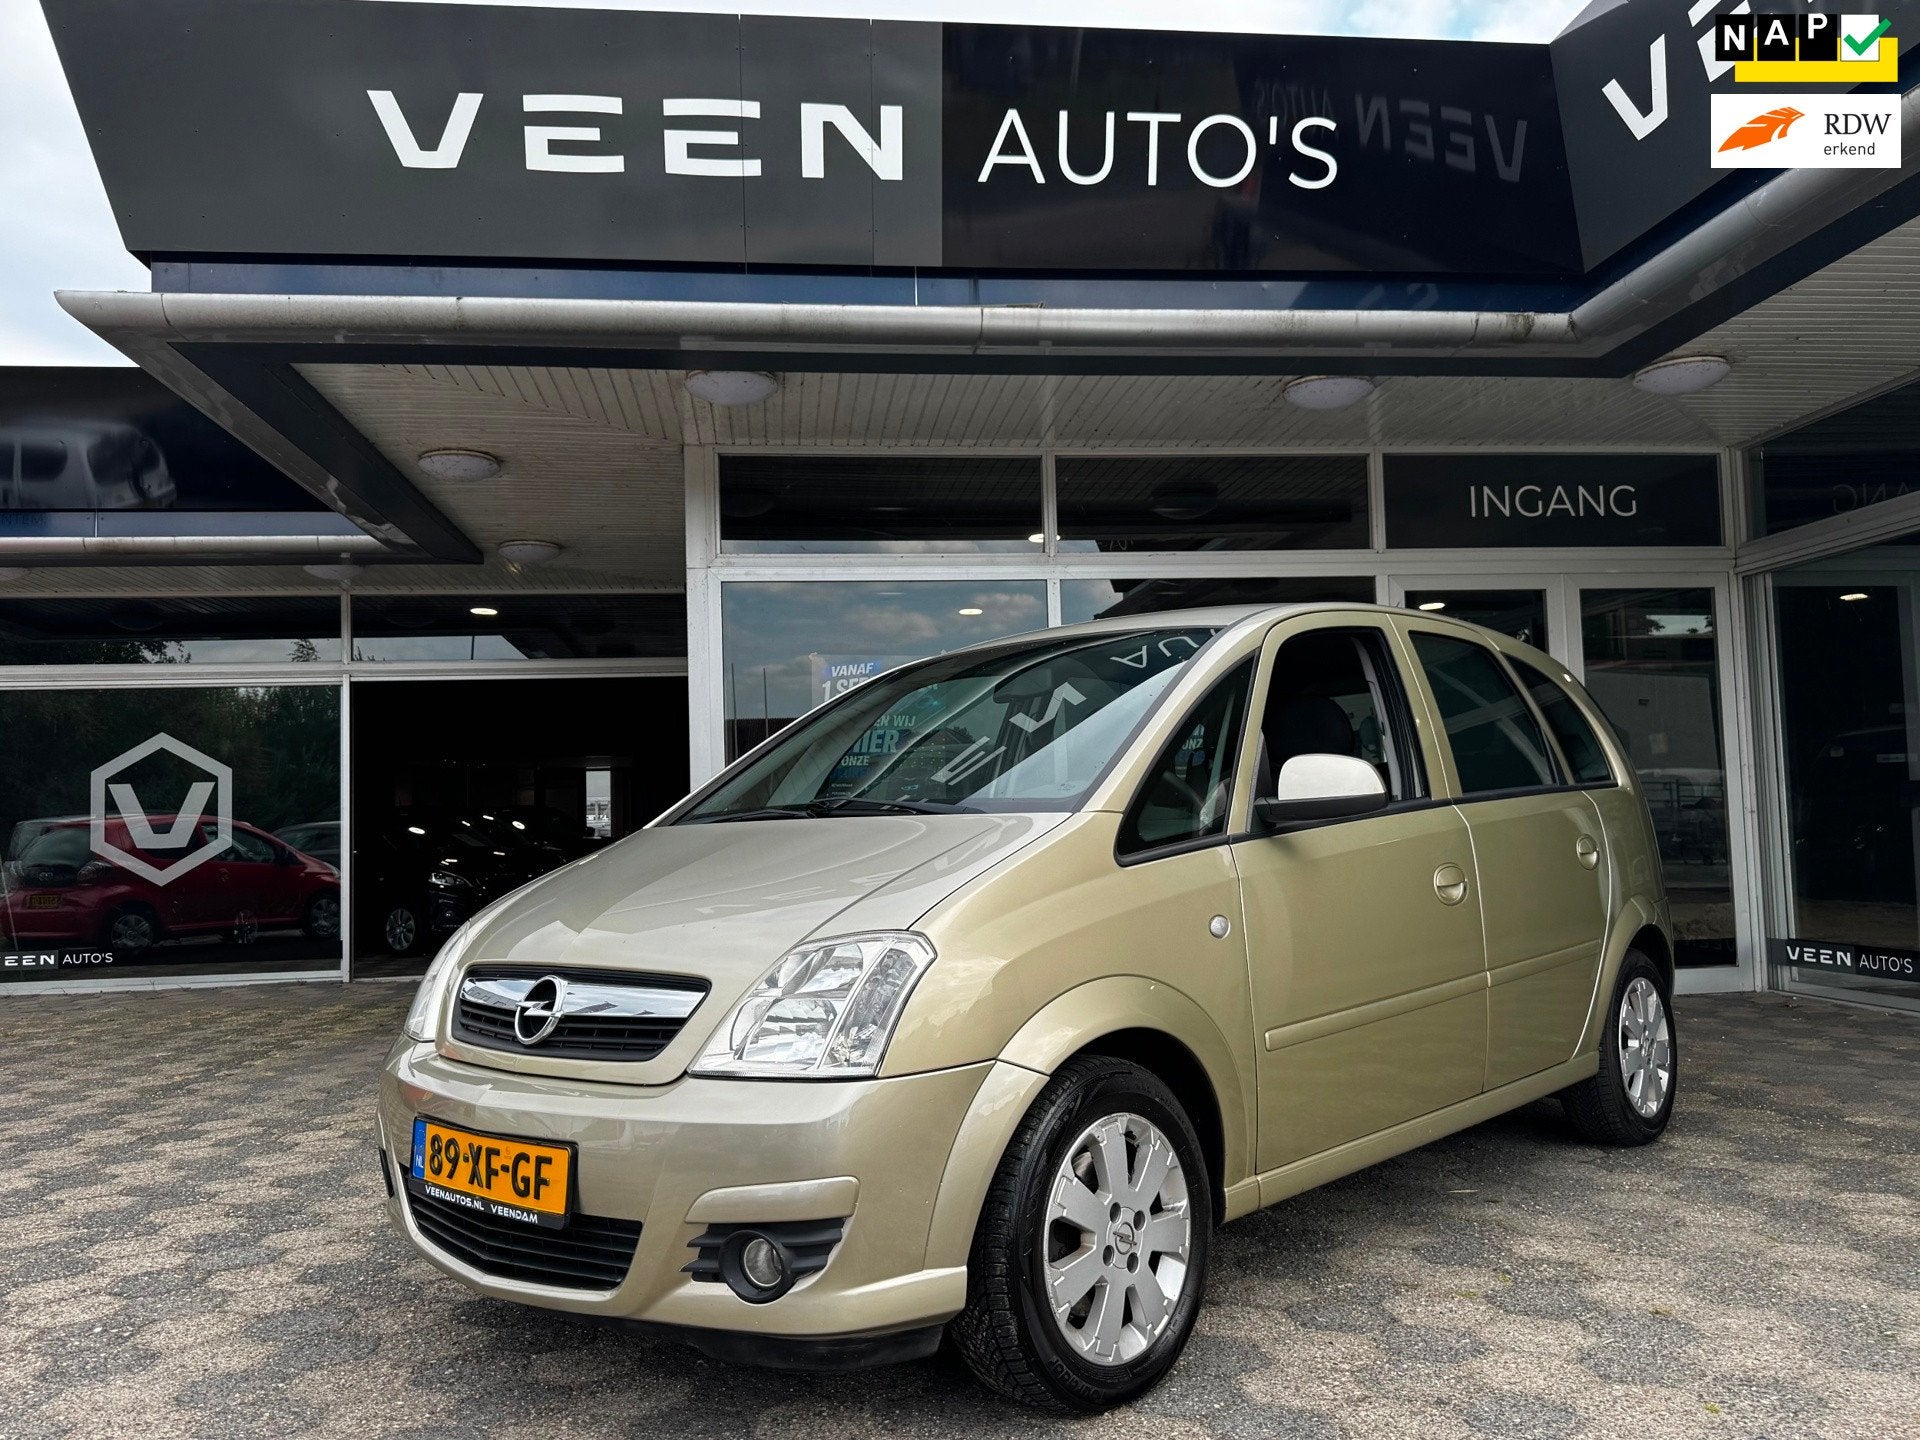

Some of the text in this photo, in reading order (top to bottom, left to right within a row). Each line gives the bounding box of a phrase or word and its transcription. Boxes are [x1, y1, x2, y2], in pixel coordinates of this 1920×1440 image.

[366, 90, 1338, 190] VEEN AUTO'S
[1470, 485, 1637, 517] INGANG
[831, 662, 874, 677] VANAF
[893, 715, 916, 727] WIJ
[853, 729, 900, 753] IER
[841, 755, 870, 766] ONZE
[108, 781, 216, 849] V
[0, 952, 113, 967] EEN AUTO'S
[1786, 945, 1914, 974] VEEN AUTO'S
[415, 1133, 553, 1201] NL 89-XF-GF
[425, 1184, 539, 1224] VEENAUTOS.NL VEENDAM
